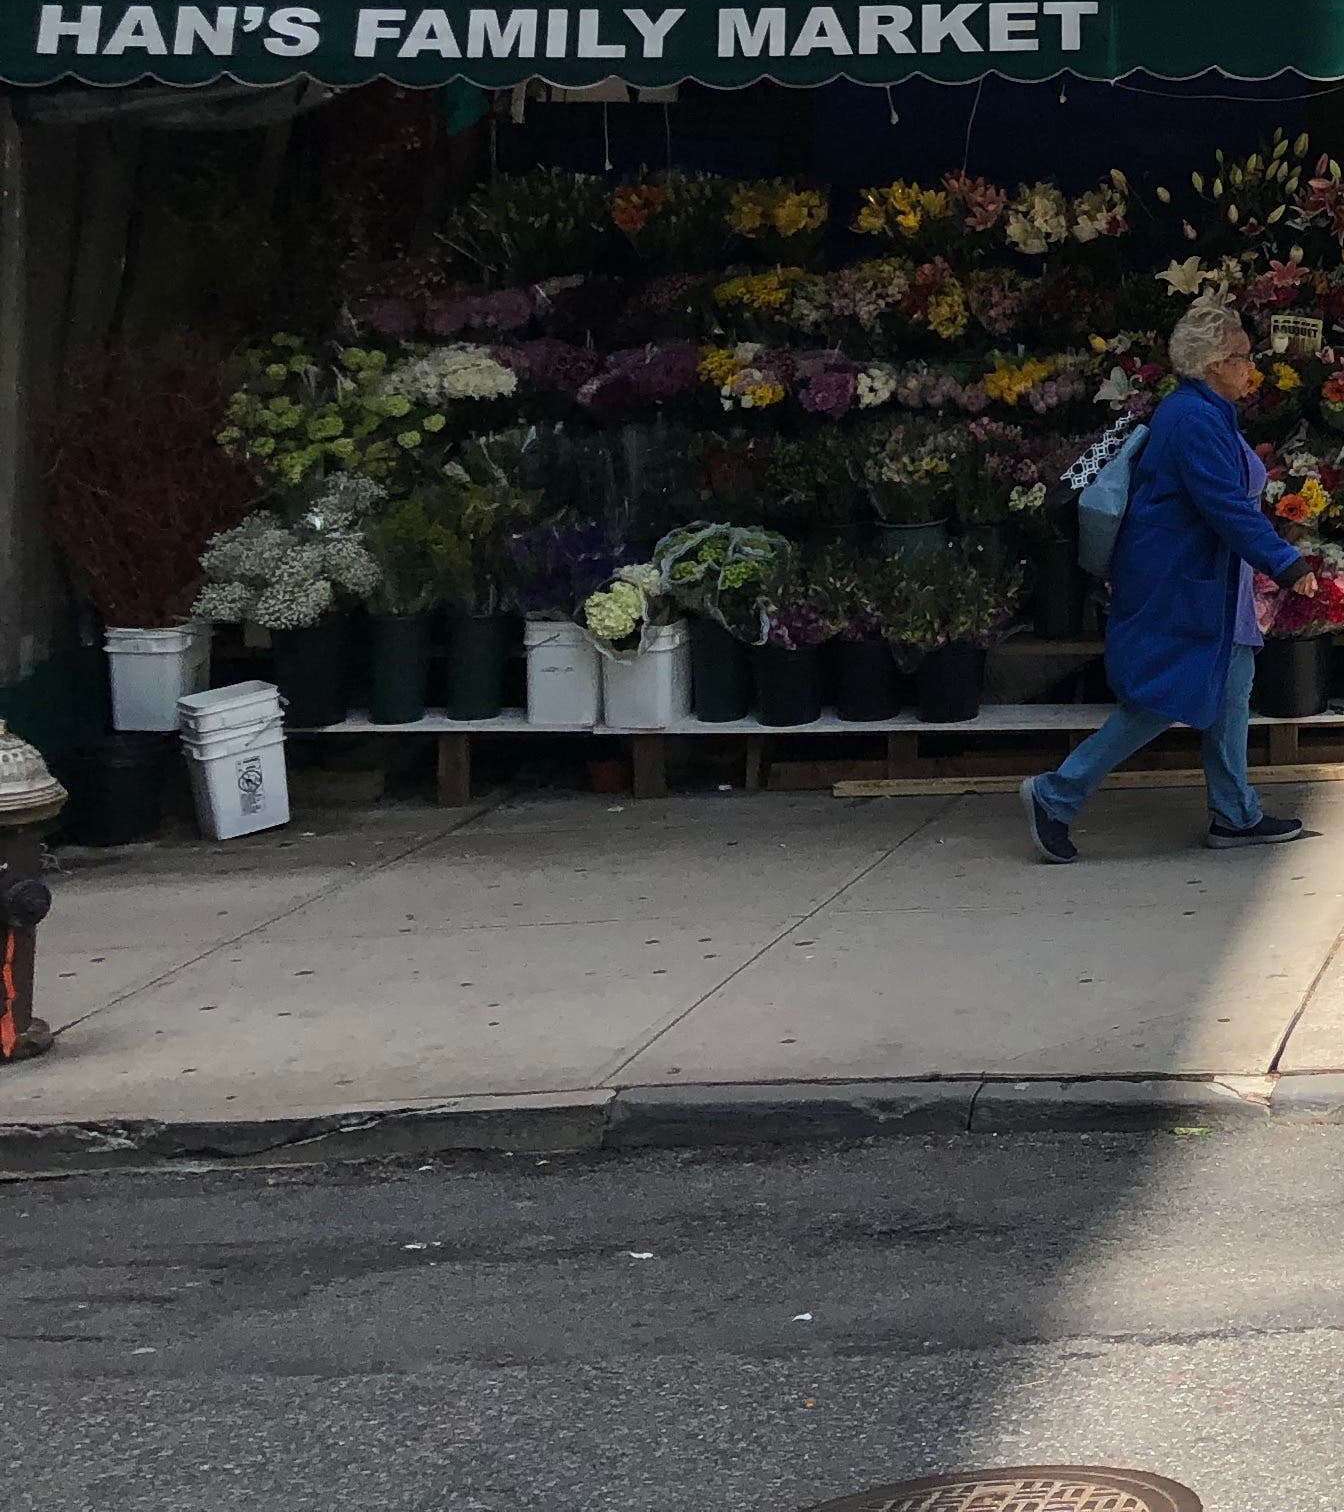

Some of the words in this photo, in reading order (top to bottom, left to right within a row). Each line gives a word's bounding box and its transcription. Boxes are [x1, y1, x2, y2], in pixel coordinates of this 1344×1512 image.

[35, 4, 321, 57] HAN'S
[353, 8, 687, 58] FAMILY
[718, 1, 1099, 58] MARKET
